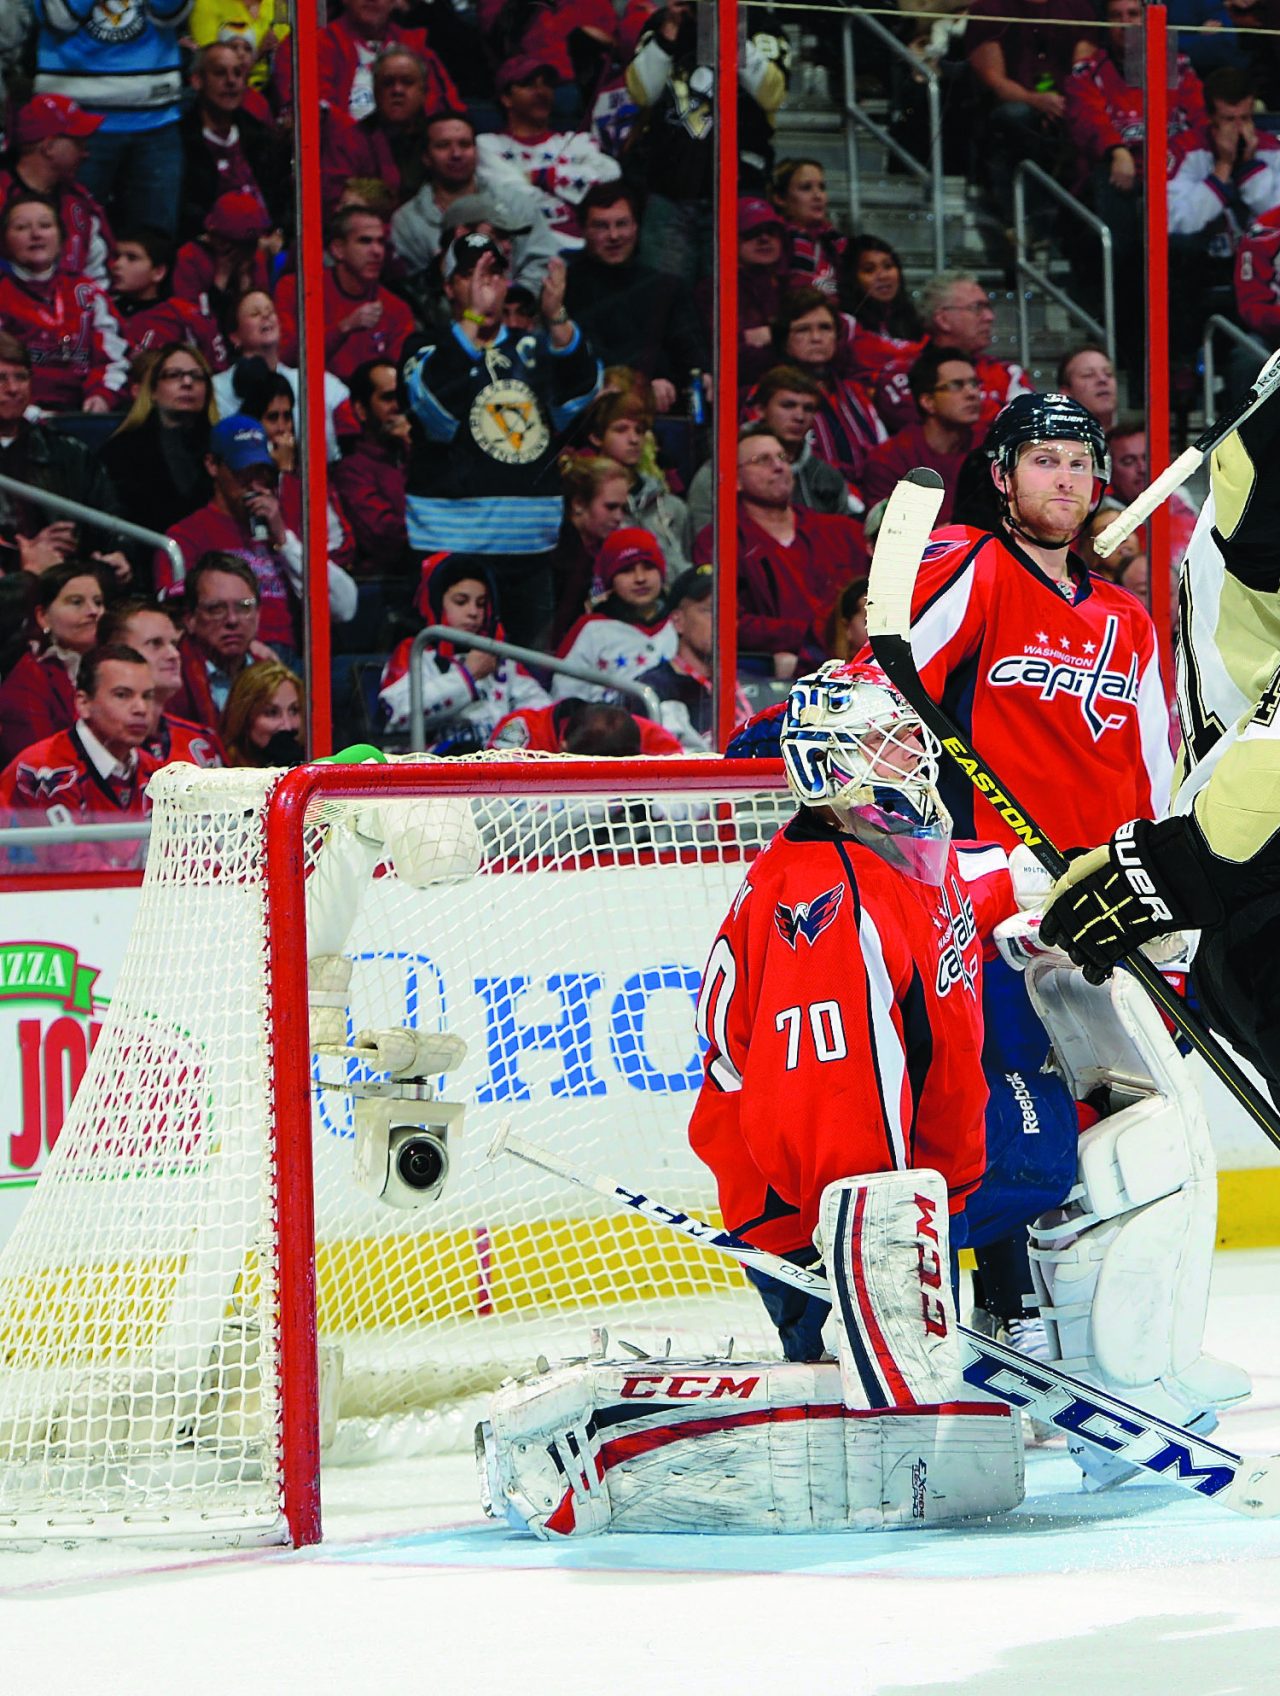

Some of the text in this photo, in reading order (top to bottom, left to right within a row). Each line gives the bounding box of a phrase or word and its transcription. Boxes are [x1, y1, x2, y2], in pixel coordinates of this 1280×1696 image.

[515, 335, 538, 369] C
[1023, 644, 1095, 668] WASHINGTON
[941, 736, 1042, 848] EASTON
[473, 965, 703, 1103] HO
[776, 999, 848, 1072] 70
[1004, 1072, 1041, 1136] Reebok
[914, 1192, 949, 1338] CCM
[619, 1376, 761, 1399] CCM
[958, 1342, 1237, 1500] CCM
